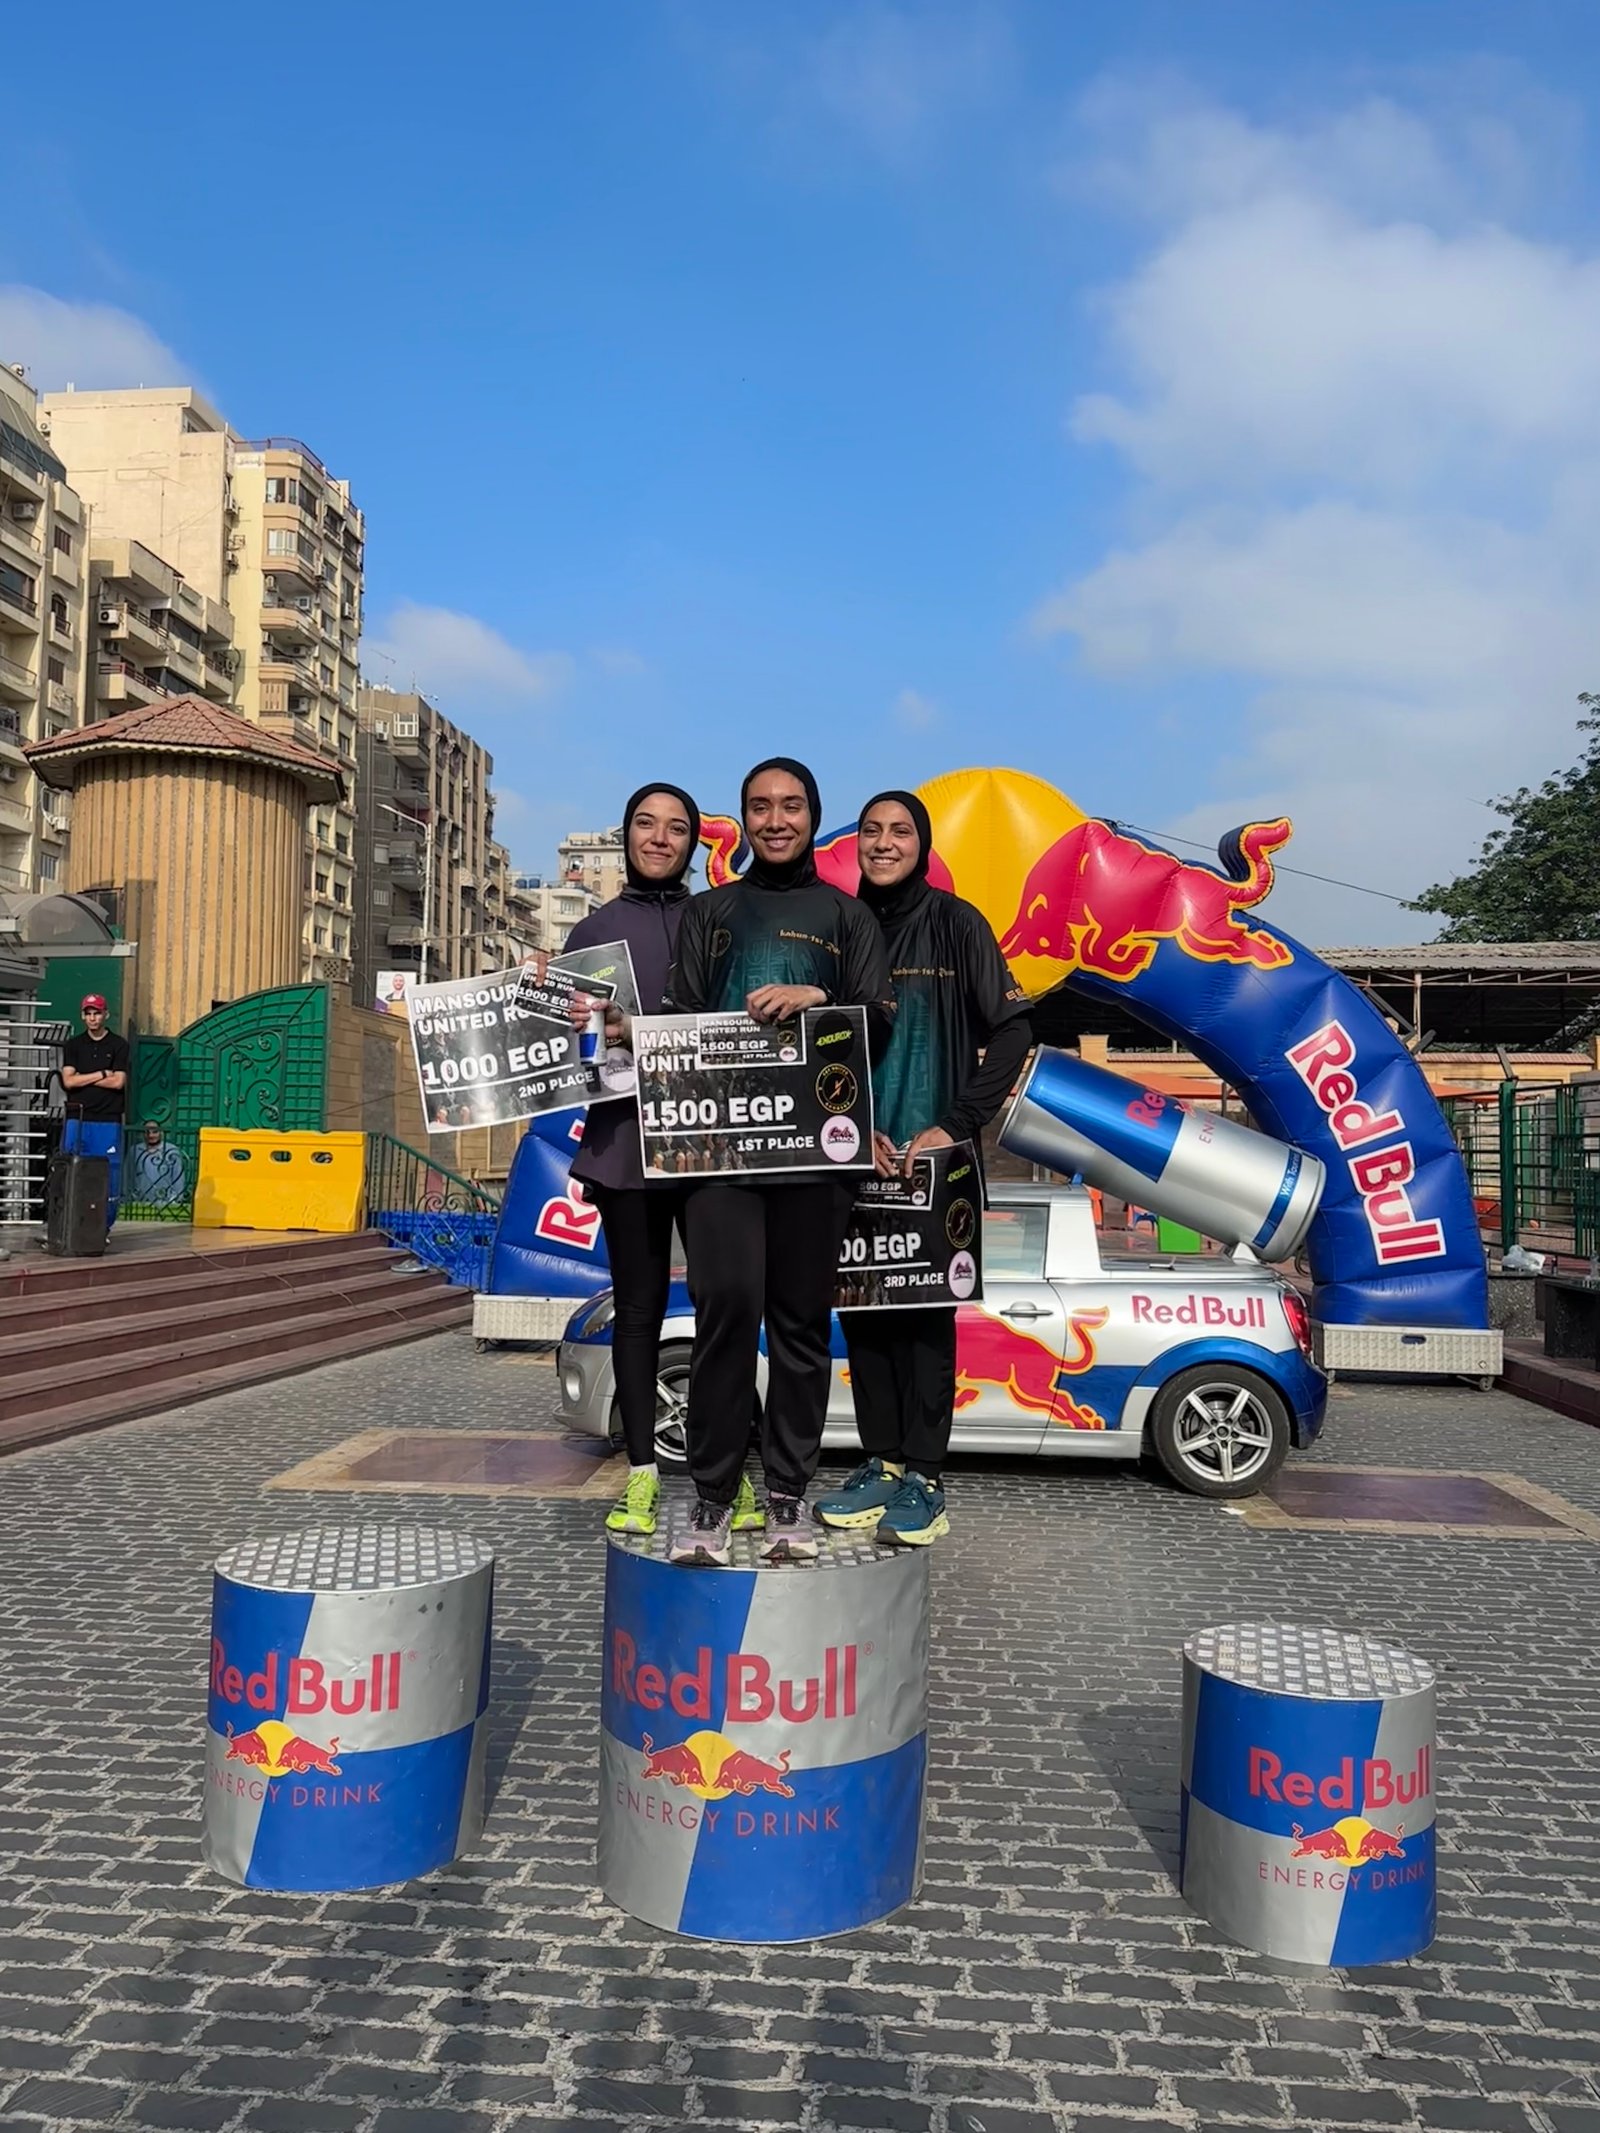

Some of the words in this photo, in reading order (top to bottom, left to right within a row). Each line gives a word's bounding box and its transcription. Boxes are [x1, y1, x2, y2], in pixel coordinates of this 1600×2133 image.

[414, 984, 518, 1013] MANSOUR
[518, 986, 548, 1001] 1000
[417, 1011, 497, 1036] UNITED
[701, 1026, 737, 1034] UNITED
[639, 1029, 698, 1048] MANS
[701, 1041, 734, 1051] 1500
[739, 1039, 769, 1050] EGP
[423, 1053, 498, 1086] 1000
[508, 1036, 569, 1072] EGP
[641, 1053, 699, 1073] UNIT
[518, 1083, 546, 1098] 2ND
[549, 1070, 594, 1092] PLACE
[643, 1098, 718, 1128] 1500
[729, 1095, 794, 1123] EGP
[737, 1138, 764, 1152] 1ST
[767, 1136, 815, 1151] PLACE
[1288, 1022, 1402, 1149] Red
[1352, 1147, 1444, 1263] Bull
[880, 1182, 902, 1191] EGP
[1280, 1177, 1295, 1197] With
[839, 1237, 866, 1264] 00
[873, 1232, 922, 1261] EGP
[884, 1274, 906, 1288] 3RD
[908, 1272, 944, 1287] PLACE
[1132, 1295, 1197, 1324] Red
[1202, 1296, 1266, 1328] Bull
[210, 1635, 278, 1712] Red
[287, 1651, 401, 1716] Bull
[613, 1627, 713, 1721] Red
[726, 1643, 858, 1725] Bull
[1248, 1745, 1354, 1810] Red
[1364, 1744, 1430, 1810] Bull
[293, 1782, 383, 1807] DRINK
[616, 1781, 721, 1833] ENERGY
[736, 1805, 840, 1837] DRINK
[1259, 1861, 1363, 1892] ENERGY
[1372, 1862, 1427, 1891] DRINK
